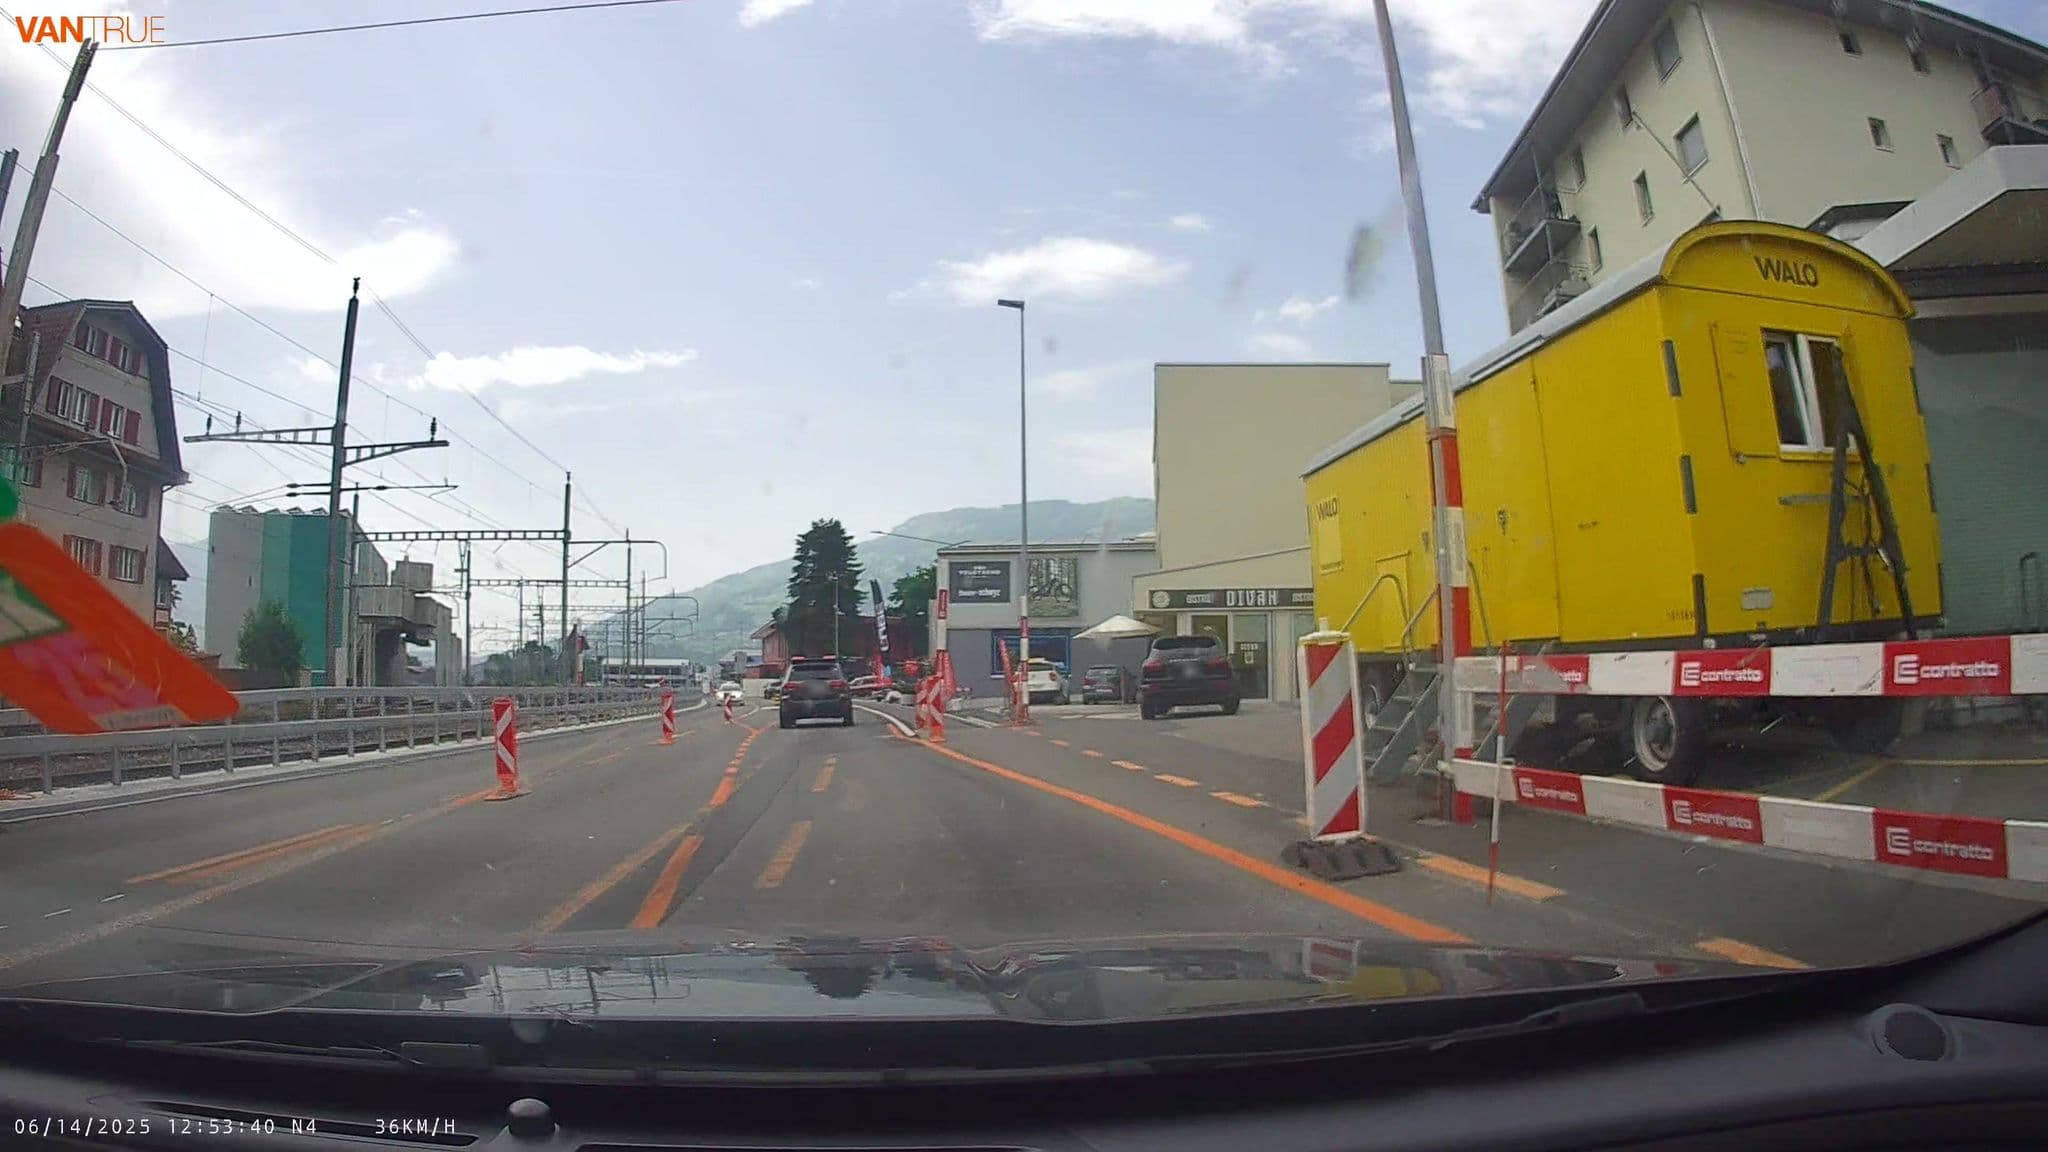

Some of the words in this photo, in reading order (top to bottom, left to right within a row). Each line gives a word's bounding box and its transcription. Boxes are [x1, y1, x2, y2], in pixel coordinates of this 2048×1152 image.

[1753, 255, 1819, 288] WALO
[1315, 497, 1338, 521] WALO
[1701, 667, 1764, 682] contratto
[1920, 660, 2000, 679] contratto
[1692, 811, 1754, 831] contratto
[1913, 840, 1994, 861] contratto
